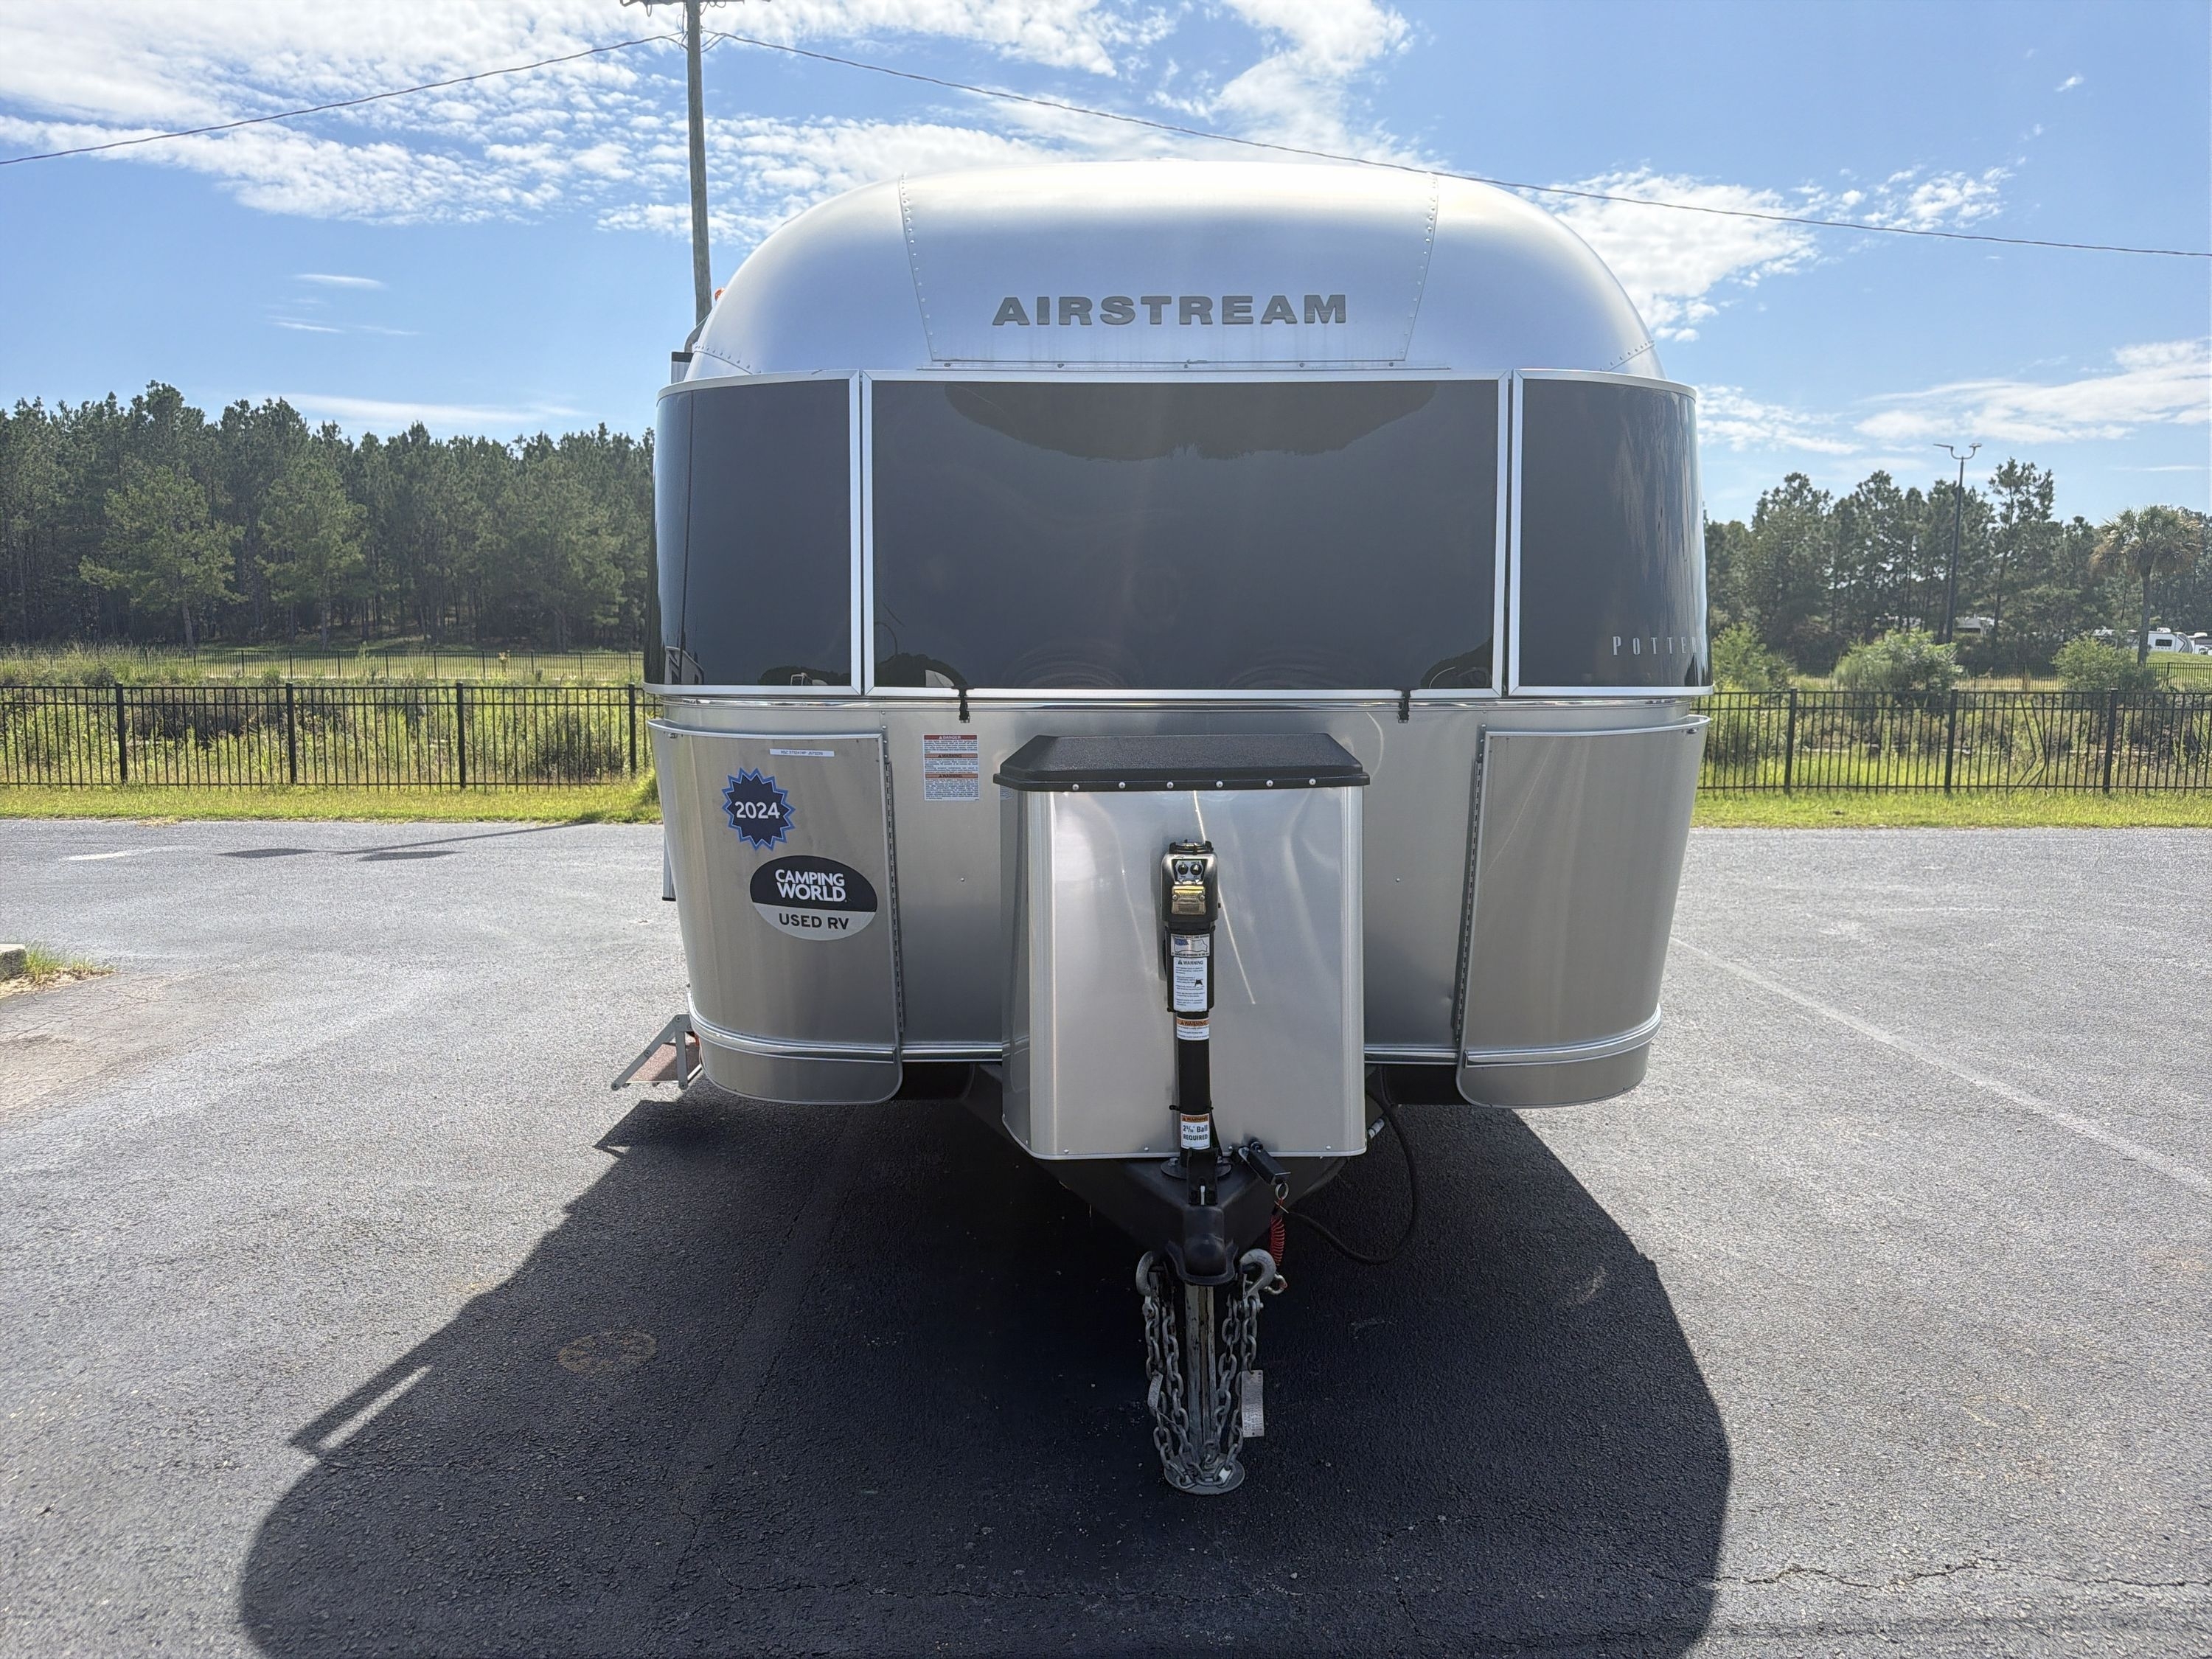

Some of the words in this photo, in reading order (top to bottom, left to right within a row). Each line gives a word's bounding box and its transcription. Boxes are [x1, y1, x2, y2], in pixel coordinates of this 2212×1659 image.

[992, 295, 1346, 325] AIRSTREAM
[735, 801, 780, 819] 2024
[775, 869, 845, 886] CAMPING
[776, 883, 846, 902] WORLD
[779, 913, 822, 928] USED
[828, 917, 849, 930] RV
[1197, 1124, 1208, 1133] Ball
